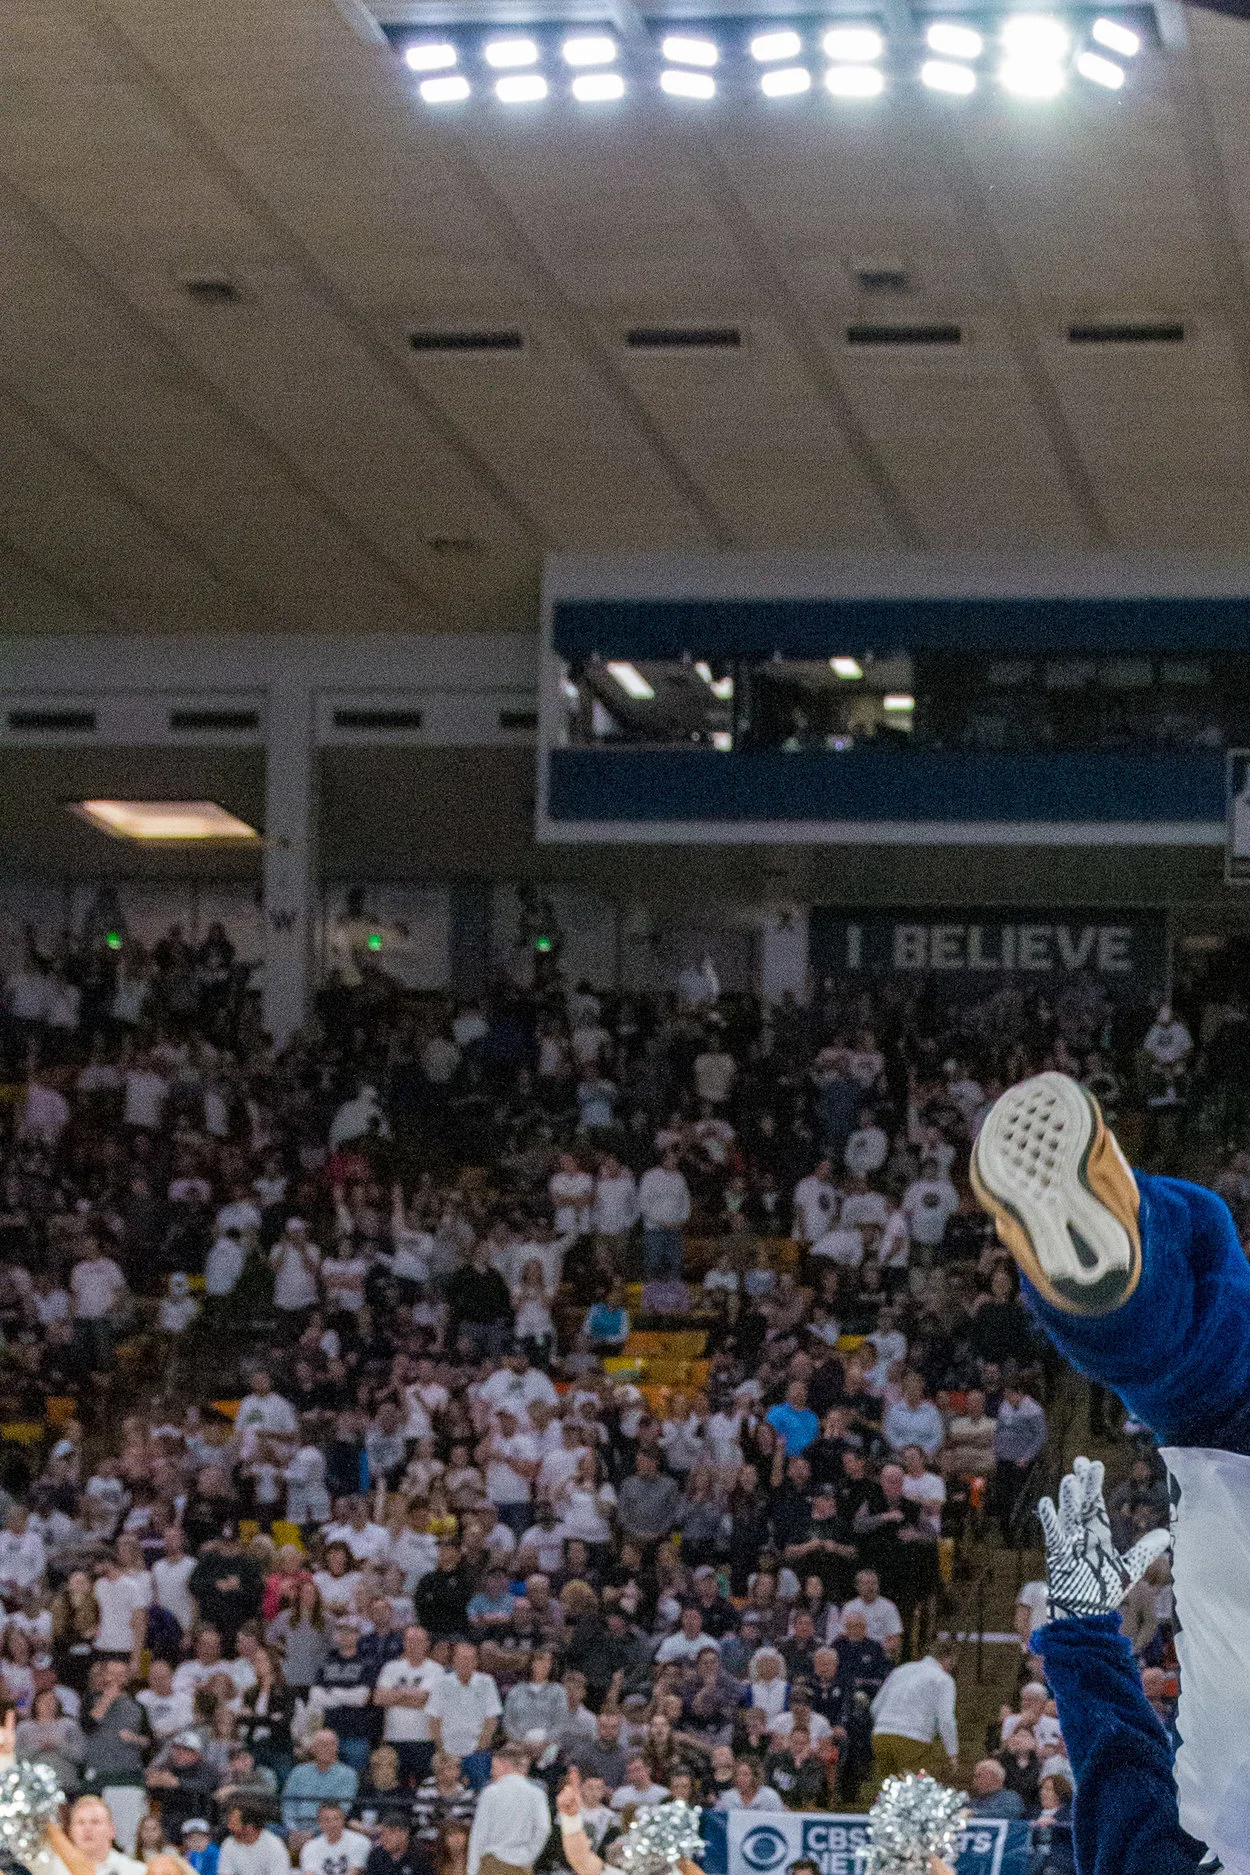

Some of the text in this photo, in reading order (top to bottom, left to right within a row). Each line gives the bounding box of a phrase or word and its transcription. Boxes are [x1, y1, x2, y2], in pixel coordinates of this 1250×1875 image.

[846, 924, 1133, 971] I BELIEVE
[806, 1825, 867, 1851] CBS
